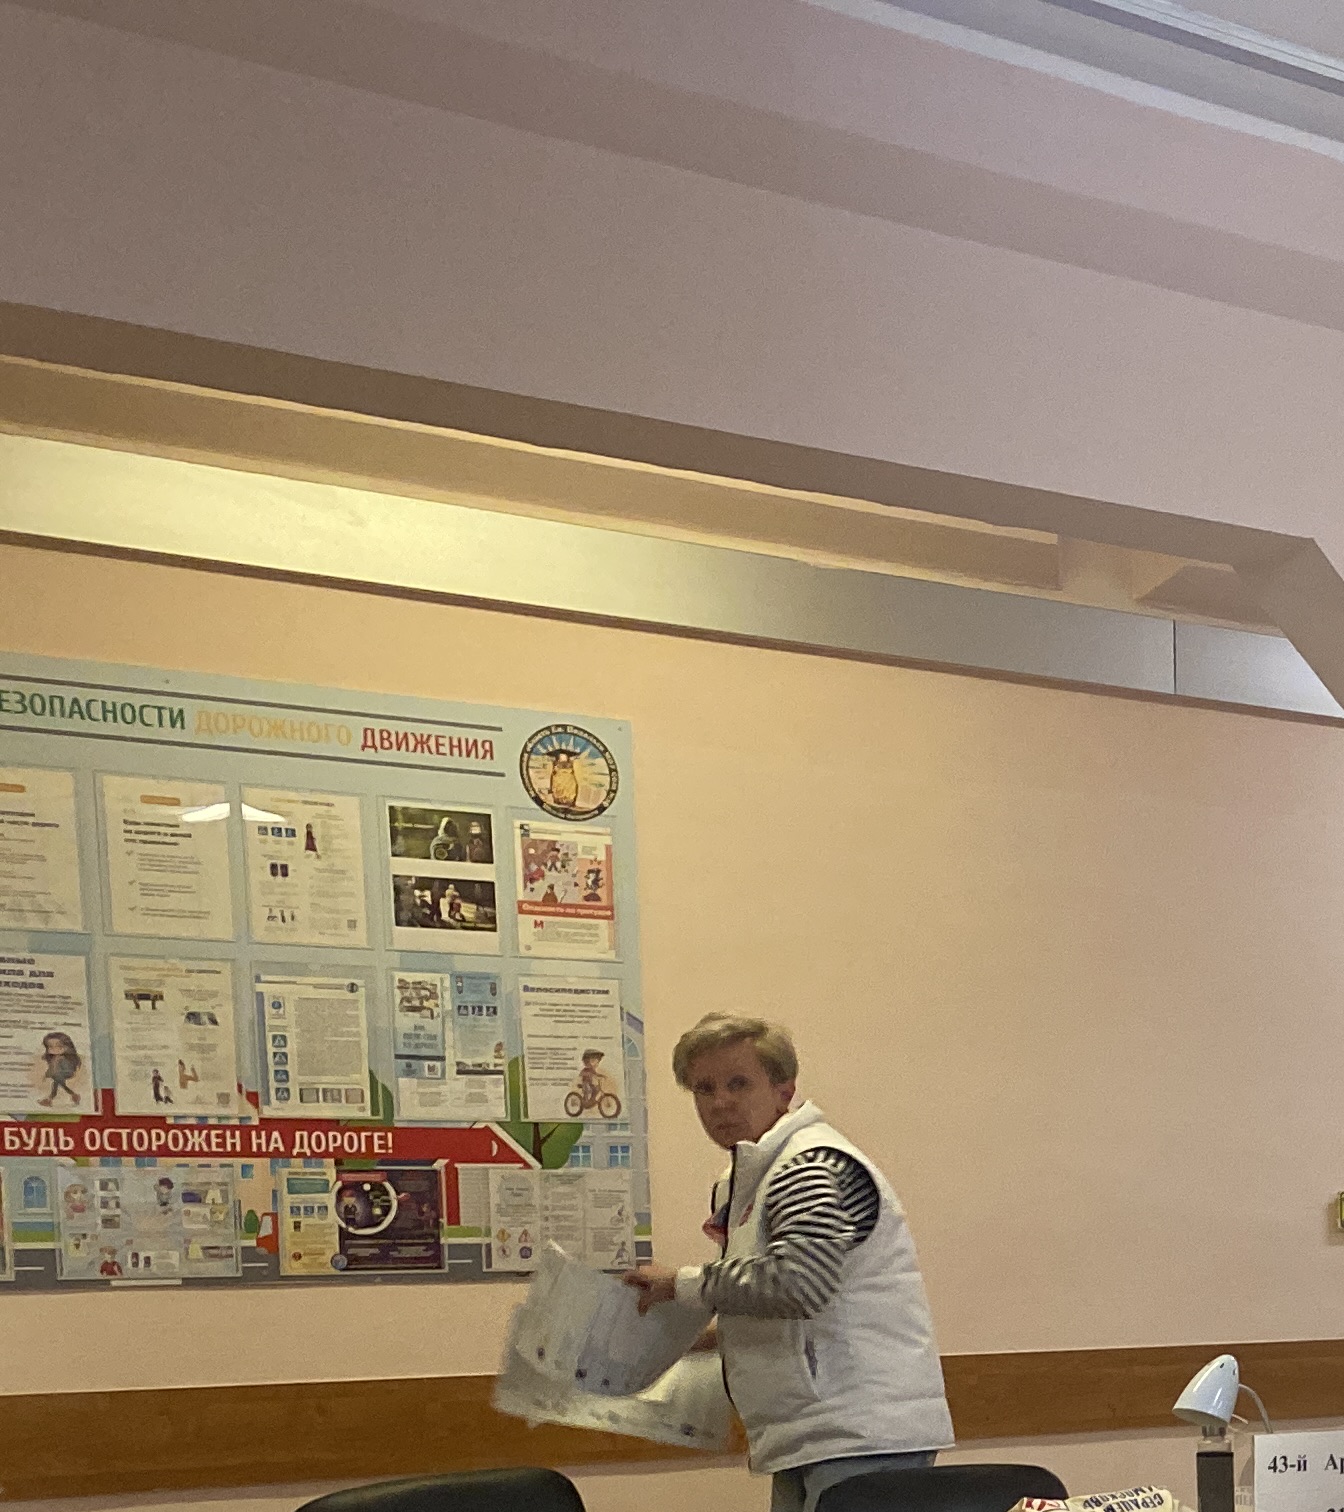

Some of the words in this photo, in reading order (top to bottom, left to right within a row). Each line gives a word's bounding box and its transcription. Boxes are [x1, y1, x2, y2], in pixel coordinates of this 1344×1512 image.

[195, 710, 352, 746] ДОРОЖНОГО
[361, 727, 495, 761] ДВИЖЕНИЯ
[4, 1127, 74, 1154] БУДЬ
[84, 1128, 241, 1153] ОСТОРОЖЕН
[252, 1130, 285, 1153] НА
[292, 1131, 393, 1156] ДОРОГЕ!
[1267, 1454, 1308, 1474] 43-й
